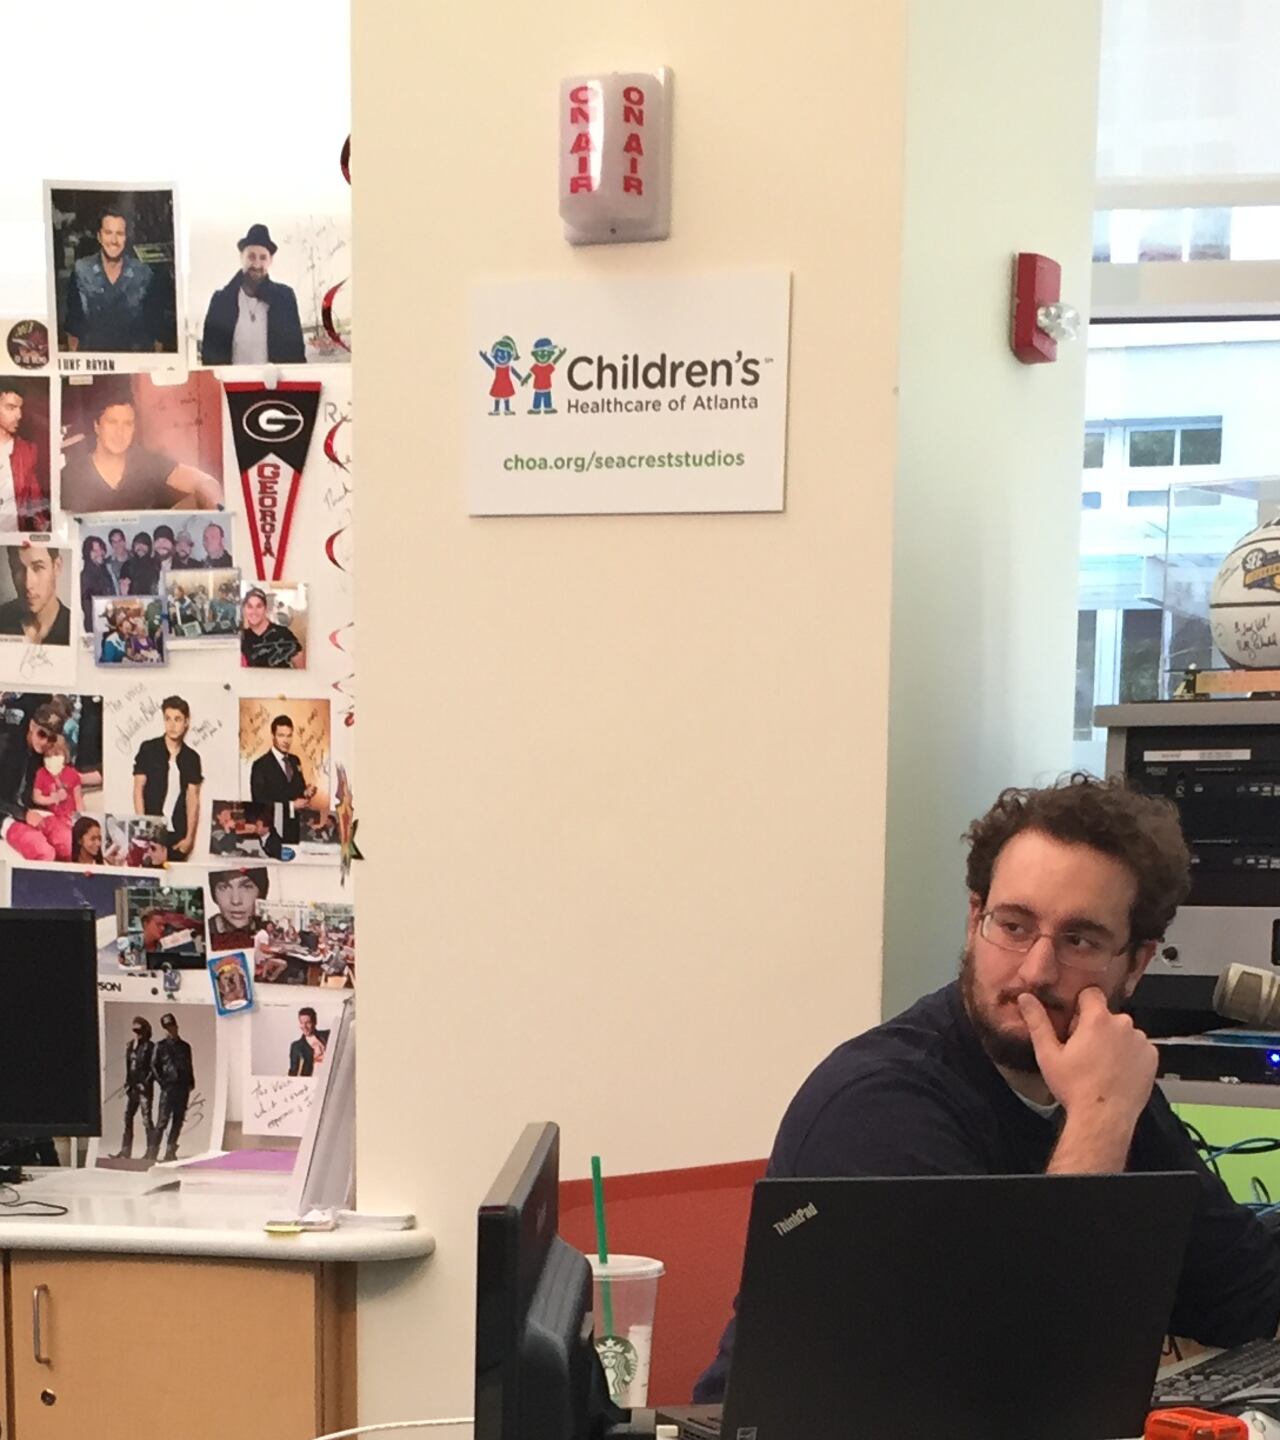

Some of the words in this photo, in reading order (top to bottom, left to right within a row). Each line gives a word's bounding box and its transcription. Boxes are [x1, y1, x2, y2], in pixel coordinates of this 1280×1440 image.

[86, 359, 116, 371] BRYAN
[566, 350, 761, 392] Children's
[566, 396, 663, 415] Healthcare
[668, 394, 687, 411] of
[692, 394, 759, 411] Atlanta
[502, 449, 746, 474] choa.org/seacreststudios
[256, 462, 282, 560] GEORGIA
[773, 1201, 819, 1236] ThinkPad
